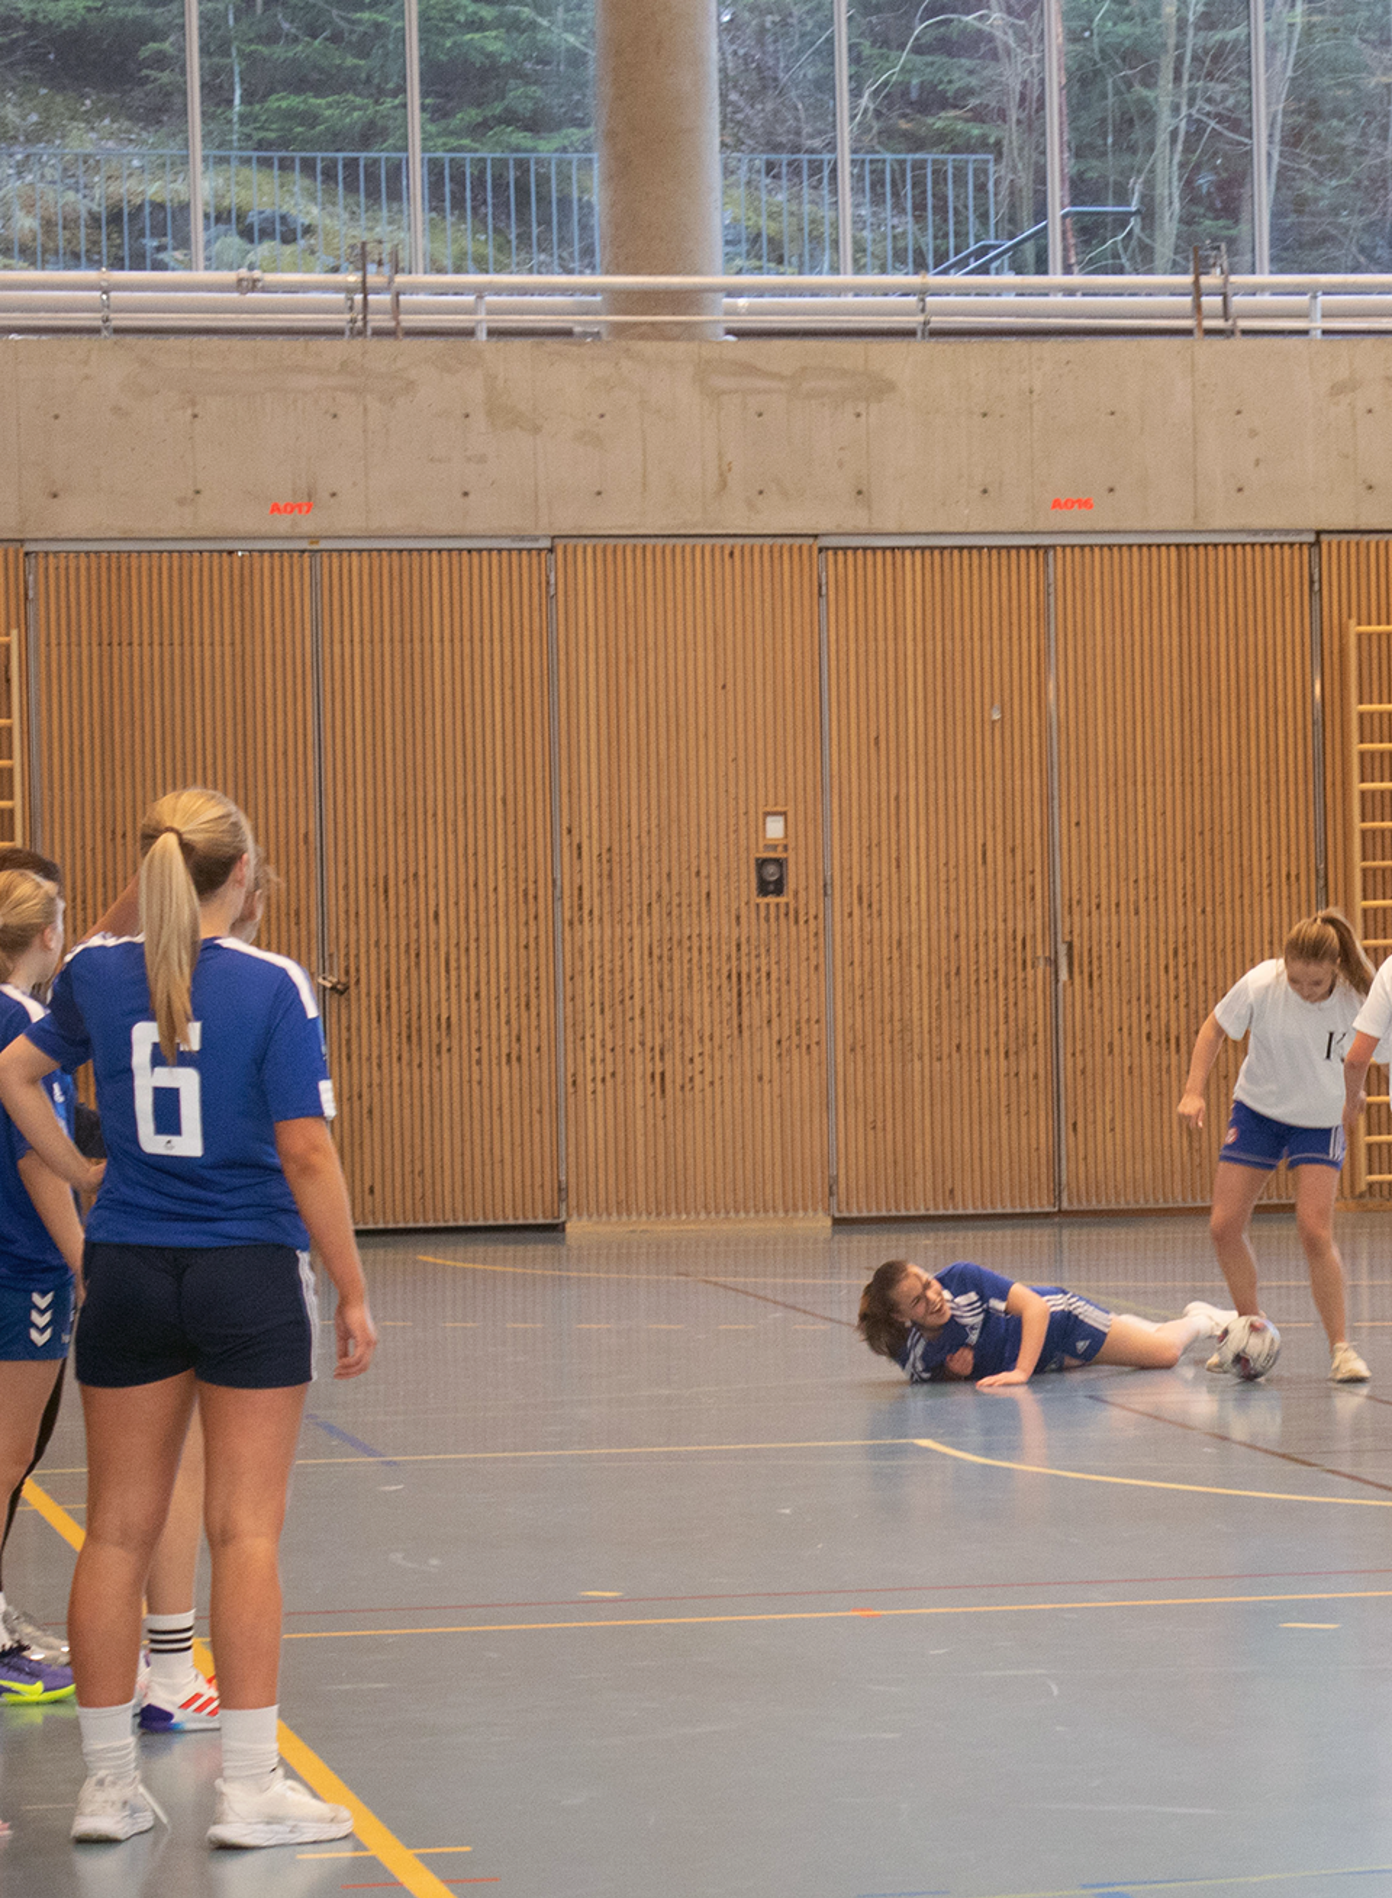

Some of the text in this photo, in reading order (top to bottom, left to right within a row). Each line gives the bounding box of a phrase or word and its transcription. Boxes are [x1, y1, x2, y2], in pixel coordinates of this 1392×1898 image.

[269, 501, 314, 515] A017
[1050, 497, 1095, 511] A016
[1324, 1030, 1348, 1064] K
[131, 1020, 203, 1157] 6
